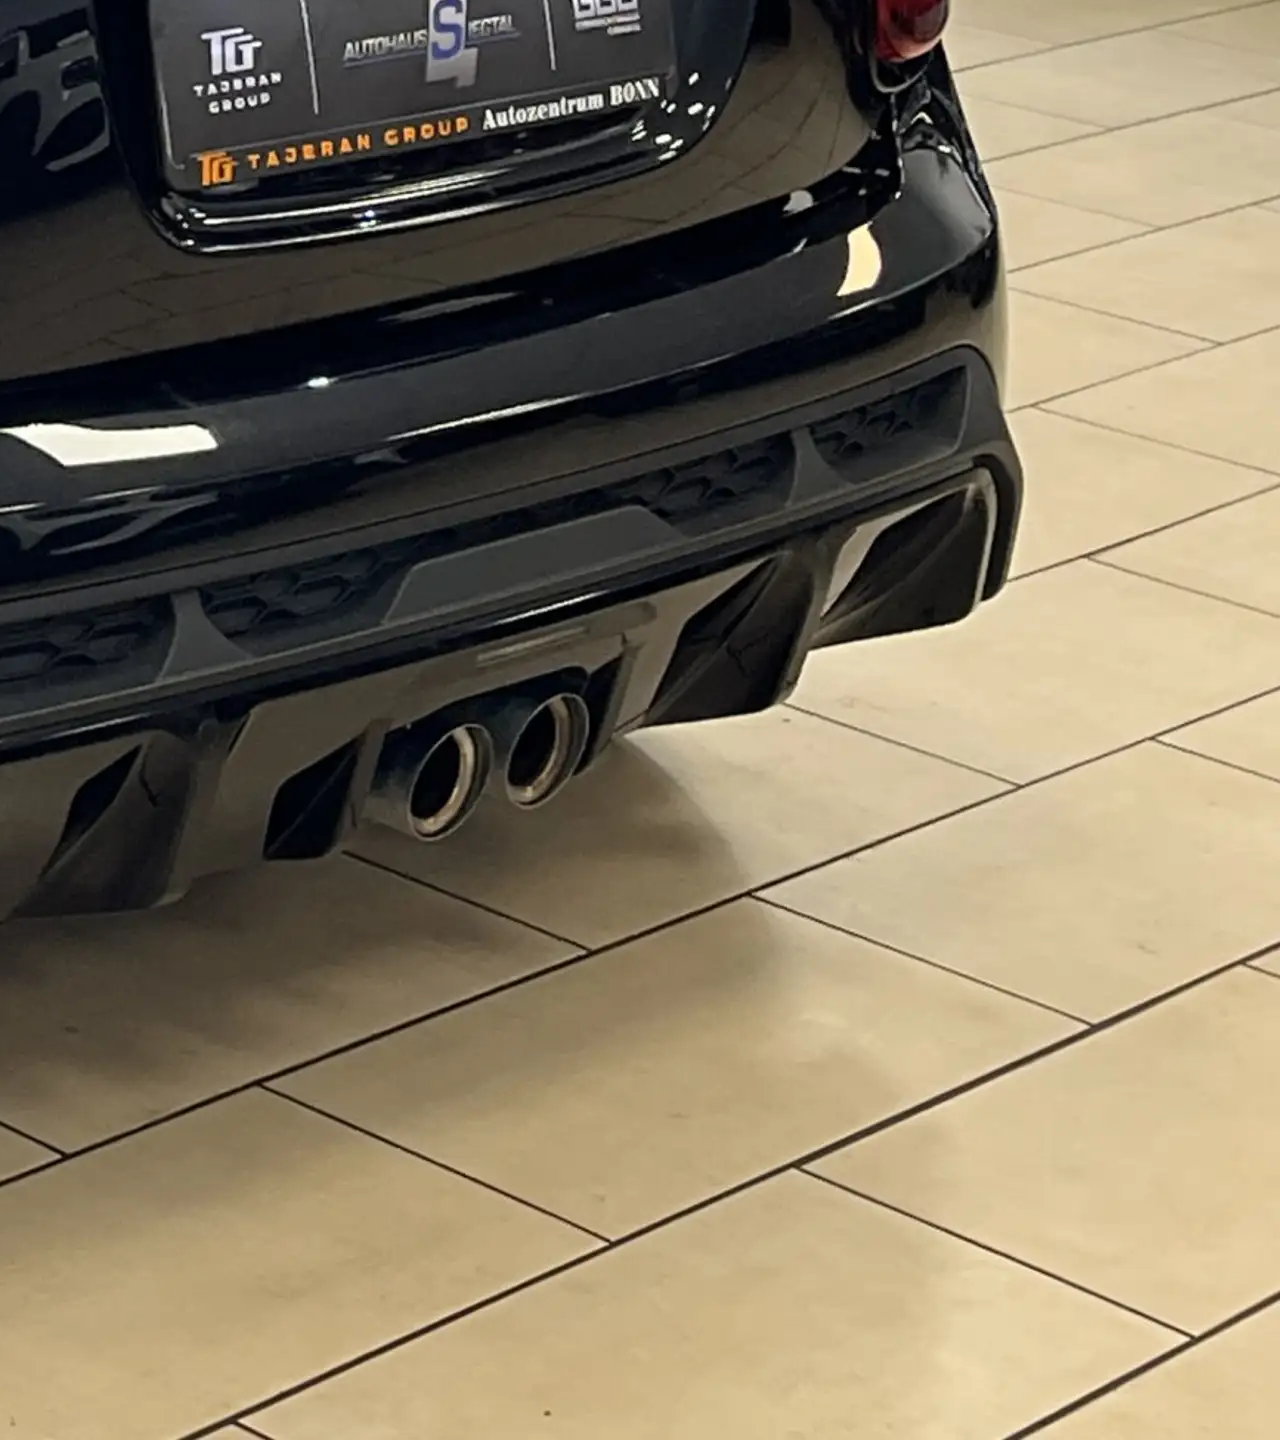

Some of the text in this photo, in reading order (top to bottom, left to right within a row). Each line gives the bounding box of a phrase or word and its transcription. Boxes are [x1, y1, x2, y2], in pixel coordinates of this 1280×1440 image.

[343, 28, 428, 61] AUTOHAUS
[208, 91, 271, 114] GROUP
[247, 133, 371, 170] TAJERAN
[383, 116, 469, 146] GROUP
[482, 92, 604, 131] Autozentrum
[609, 76, 660, 107] BONN
